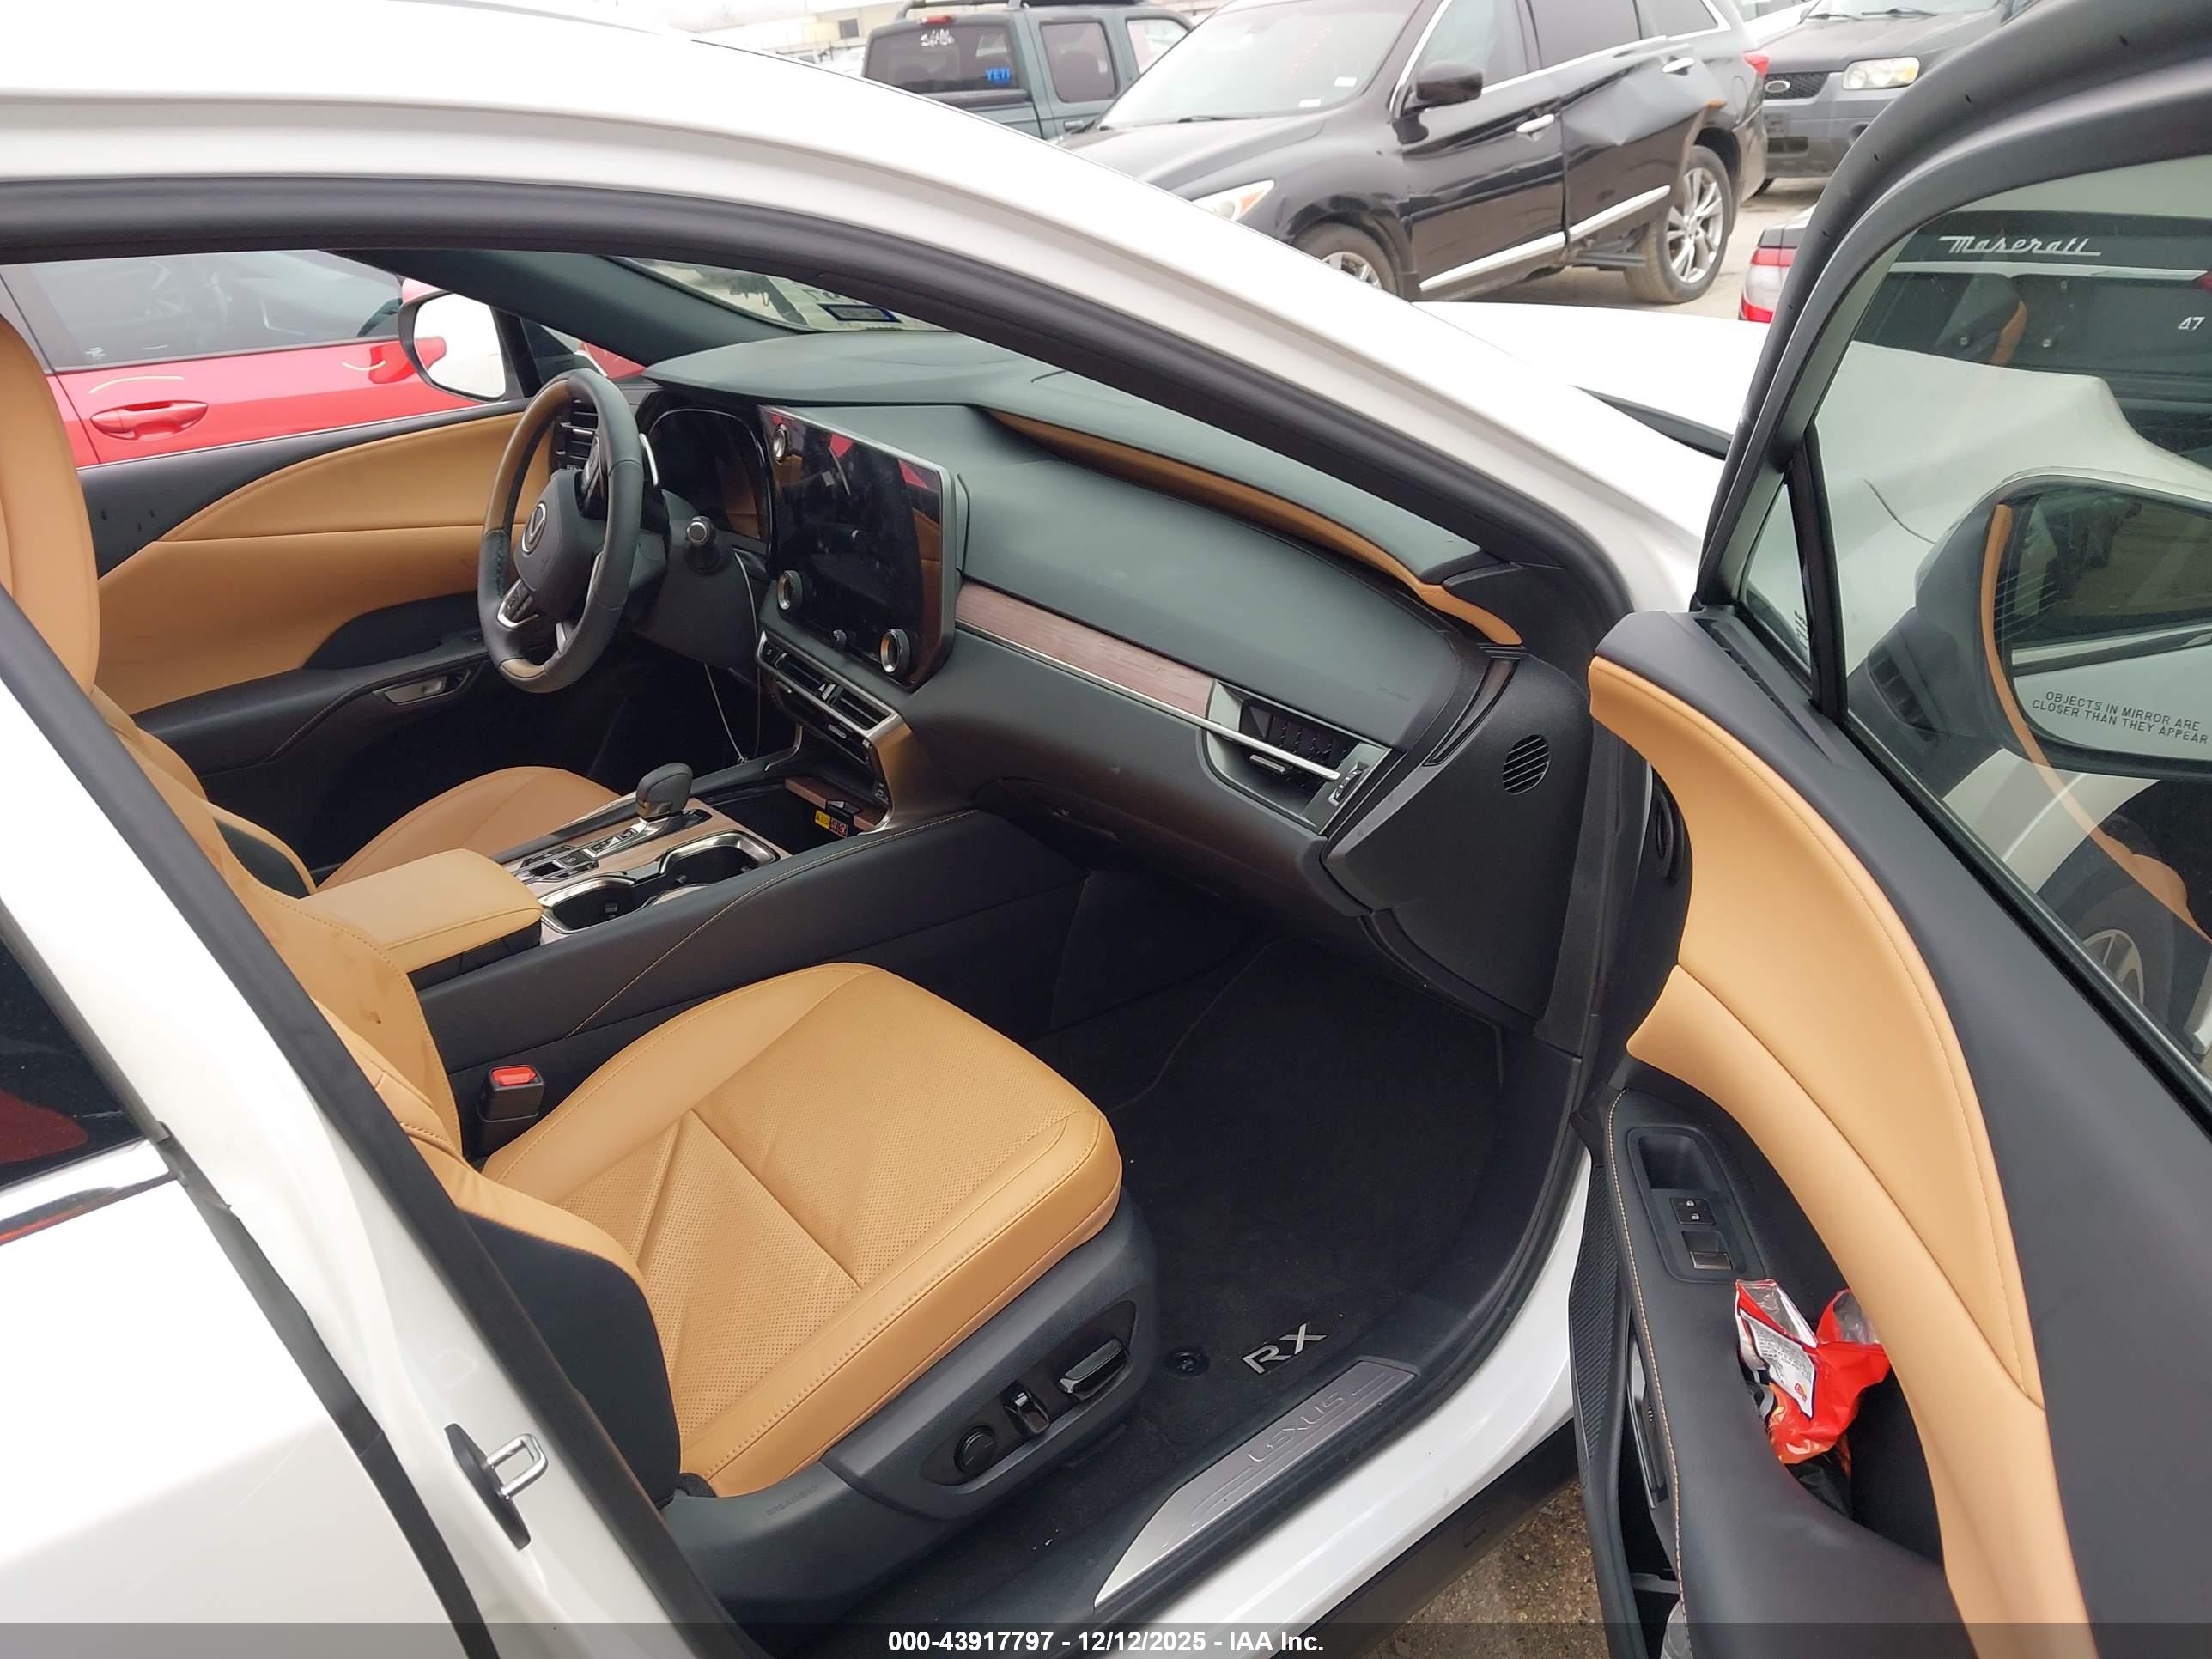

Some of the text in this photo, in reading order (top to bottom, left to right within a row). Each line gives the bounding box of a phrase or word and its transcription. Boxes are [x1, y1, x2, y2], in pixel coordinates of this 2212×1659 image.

[1939, 235, 2102, 256] Maserati
[2032, 700, 2208, 744] CLOSER THAN THEY APPEAR
[2046, 691, 2201, 731] OBJECTS IN MIRROR ARE
[1242, 1322, 1327, 1374] RX
[1247, 1391, 1345, 1462] LEXUS
